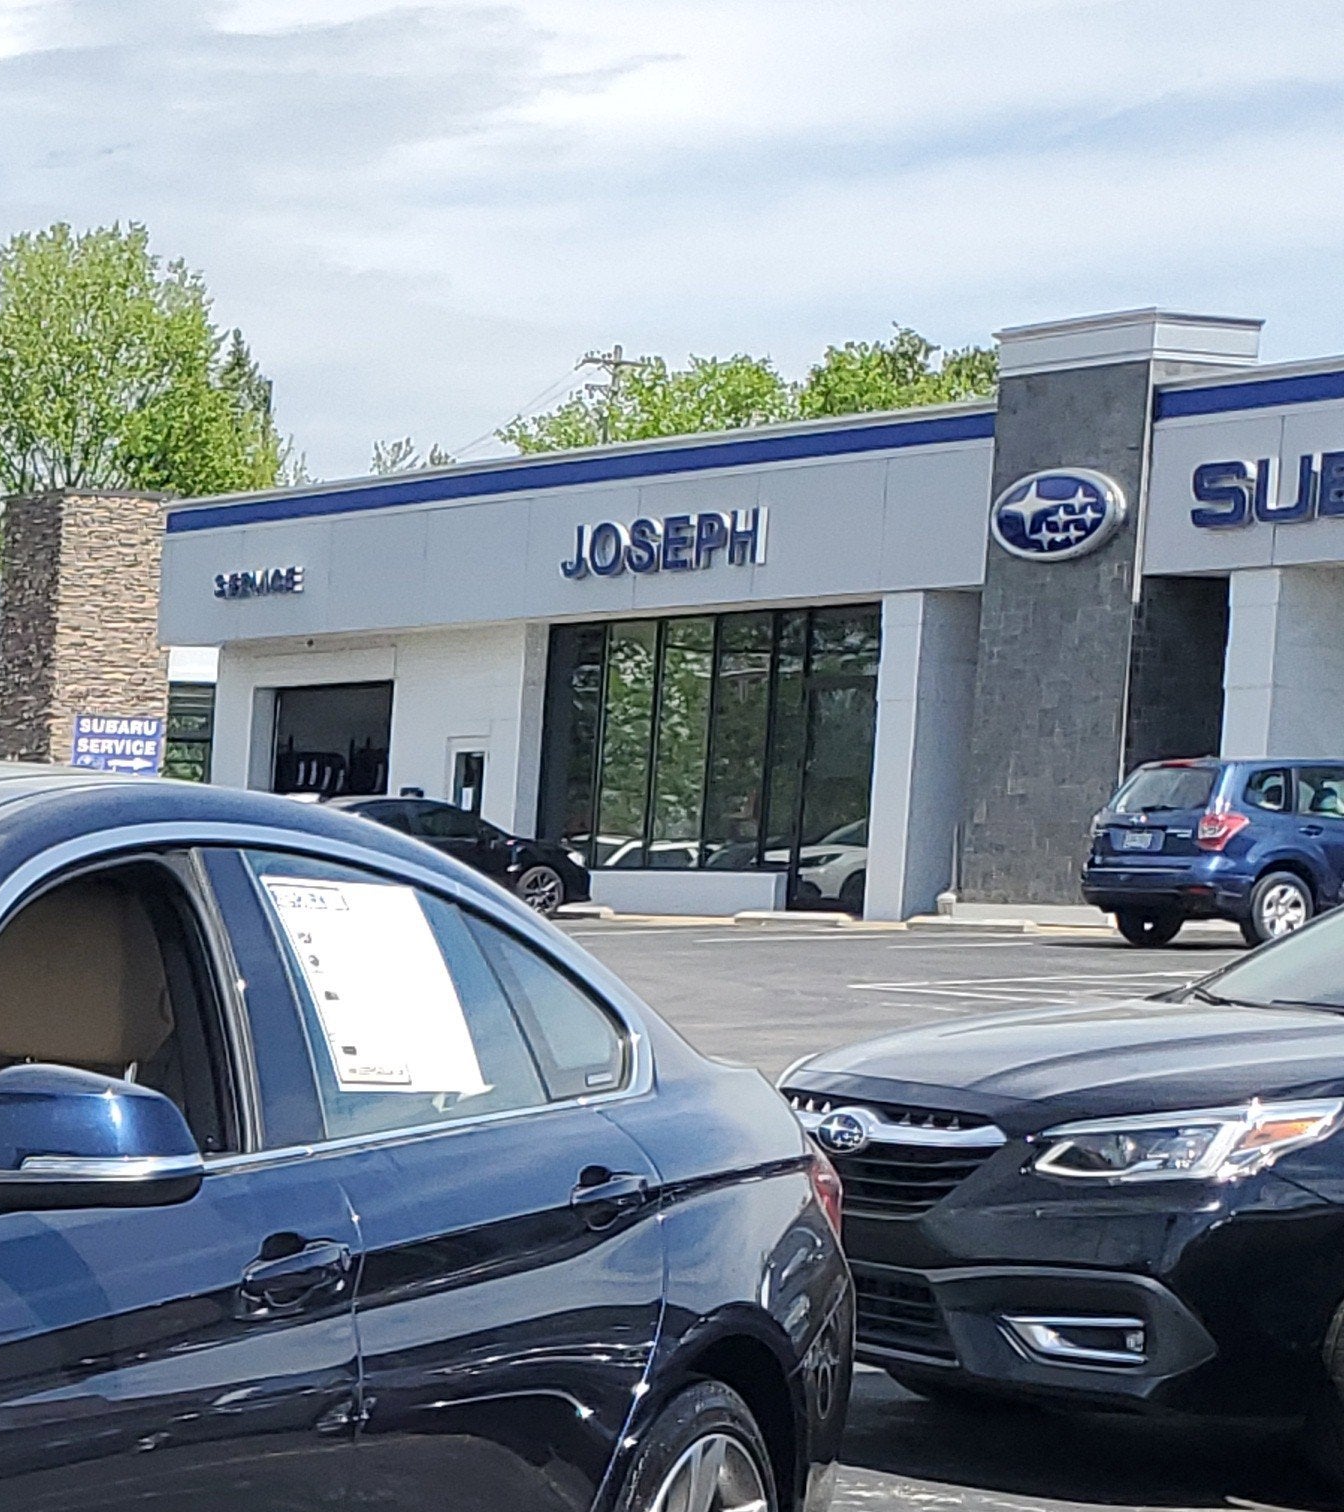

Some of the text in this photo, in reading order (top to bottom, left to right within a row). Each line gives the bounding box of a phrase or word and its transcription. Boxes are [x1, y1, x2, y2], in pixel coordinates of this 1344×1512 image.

[560, 506, 769, 580] JOSEPH
[214, 566, 305, 599] SERVICE
[79, 718, 158, 736] SUBARU
[77, 738, 157, 756] SERVICE
